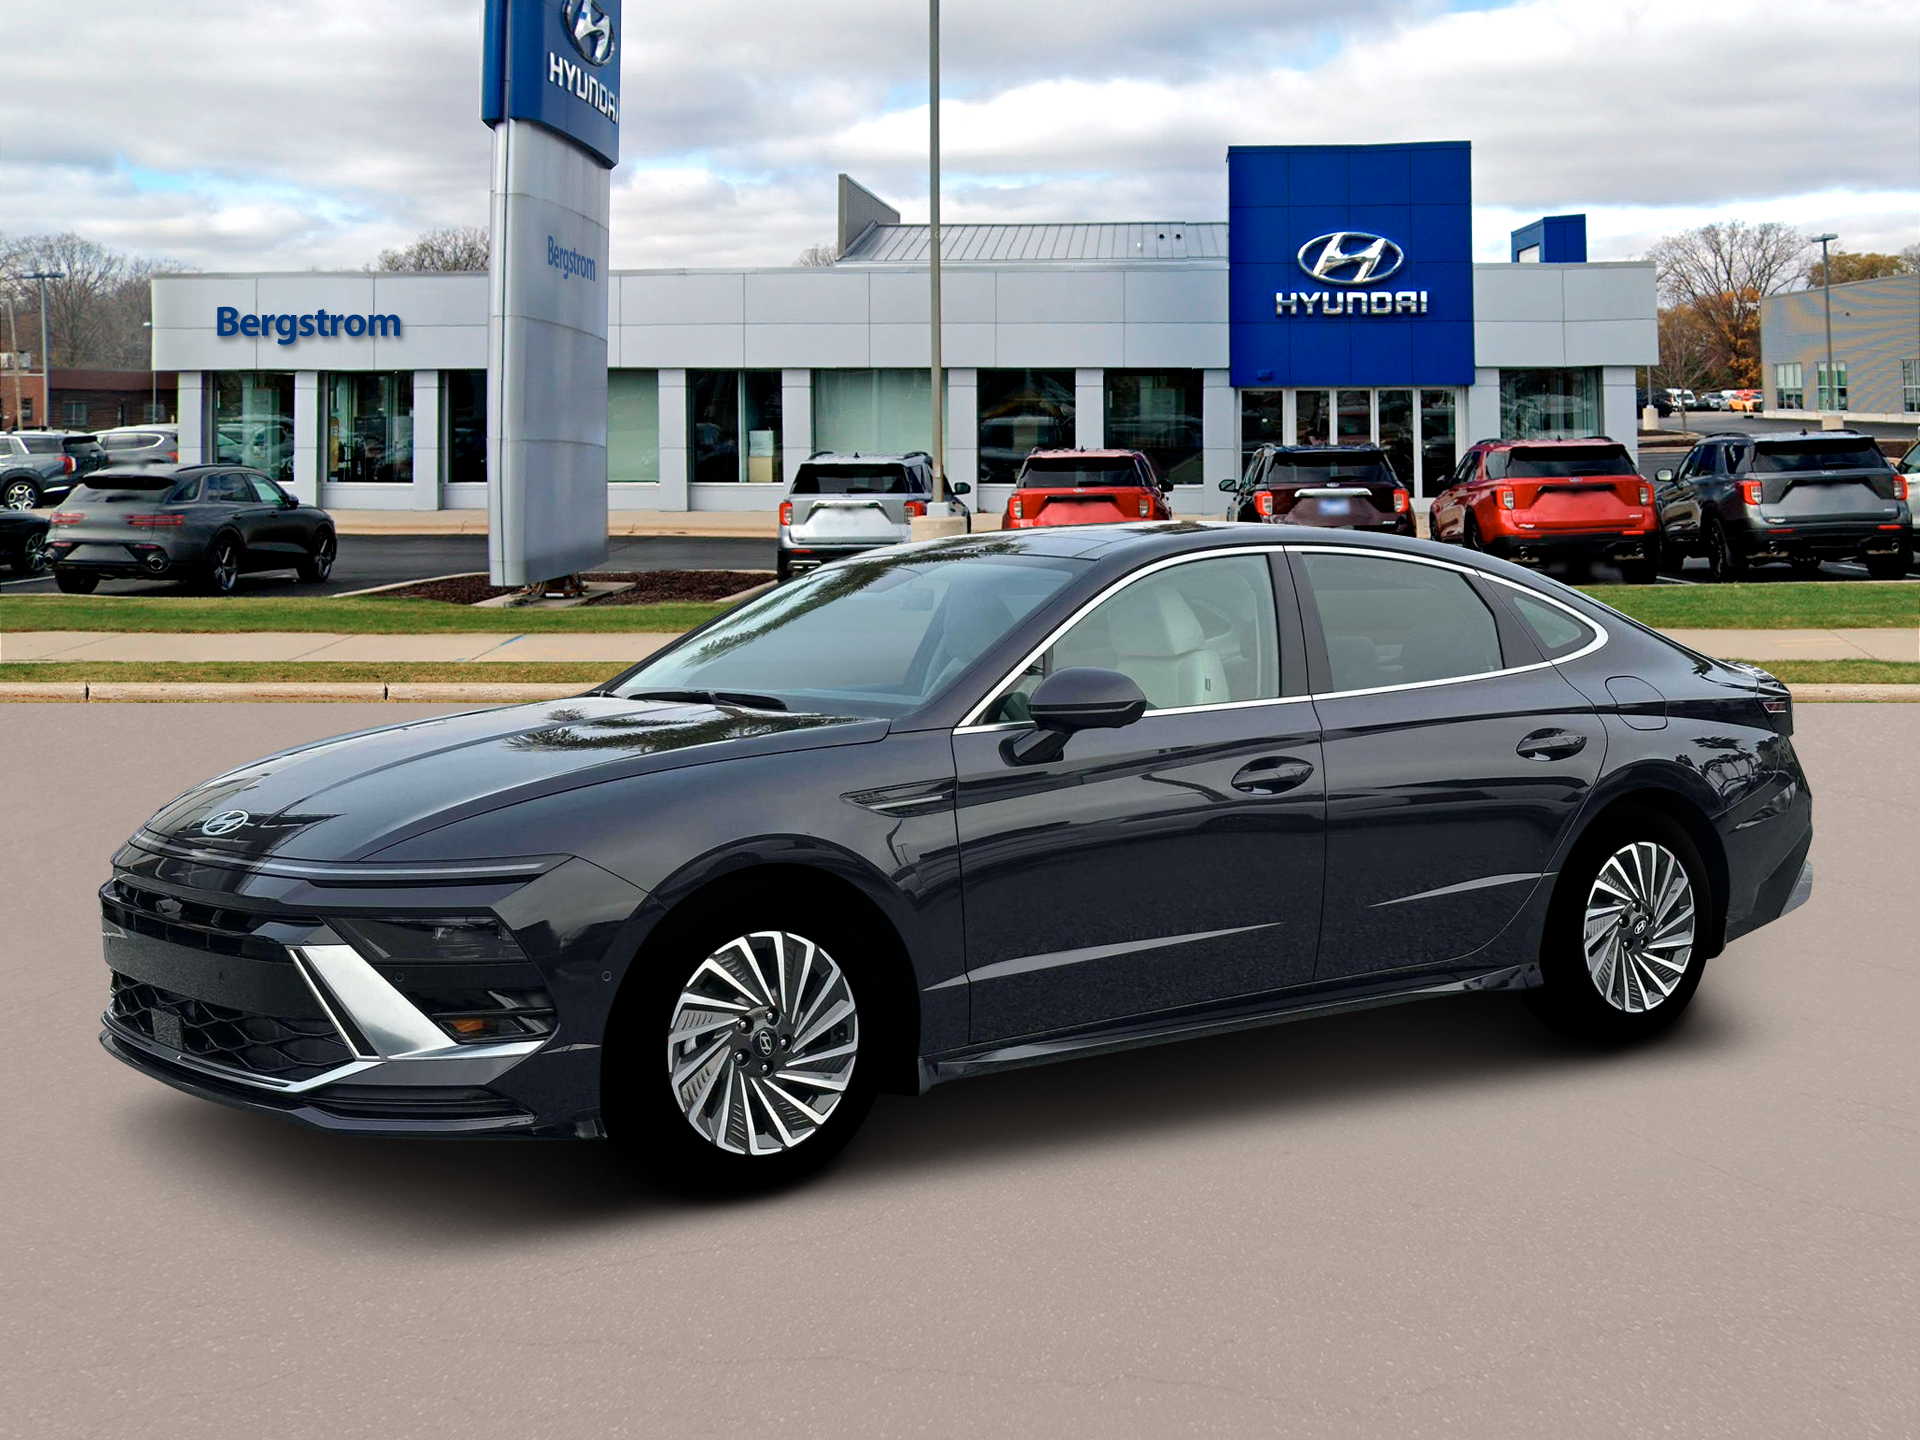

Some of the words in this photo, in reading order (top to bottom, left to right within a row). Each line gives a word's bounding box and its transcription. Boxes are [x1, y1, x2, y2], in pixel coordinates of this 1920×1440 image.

[548, 51, 619, 124] HYUNDAI
[547, 235, 596, 282] Bergstrom
[1275, 291, 1428, 315] HYUNDAI
[216, 306, 402, 346] Bergstrom
